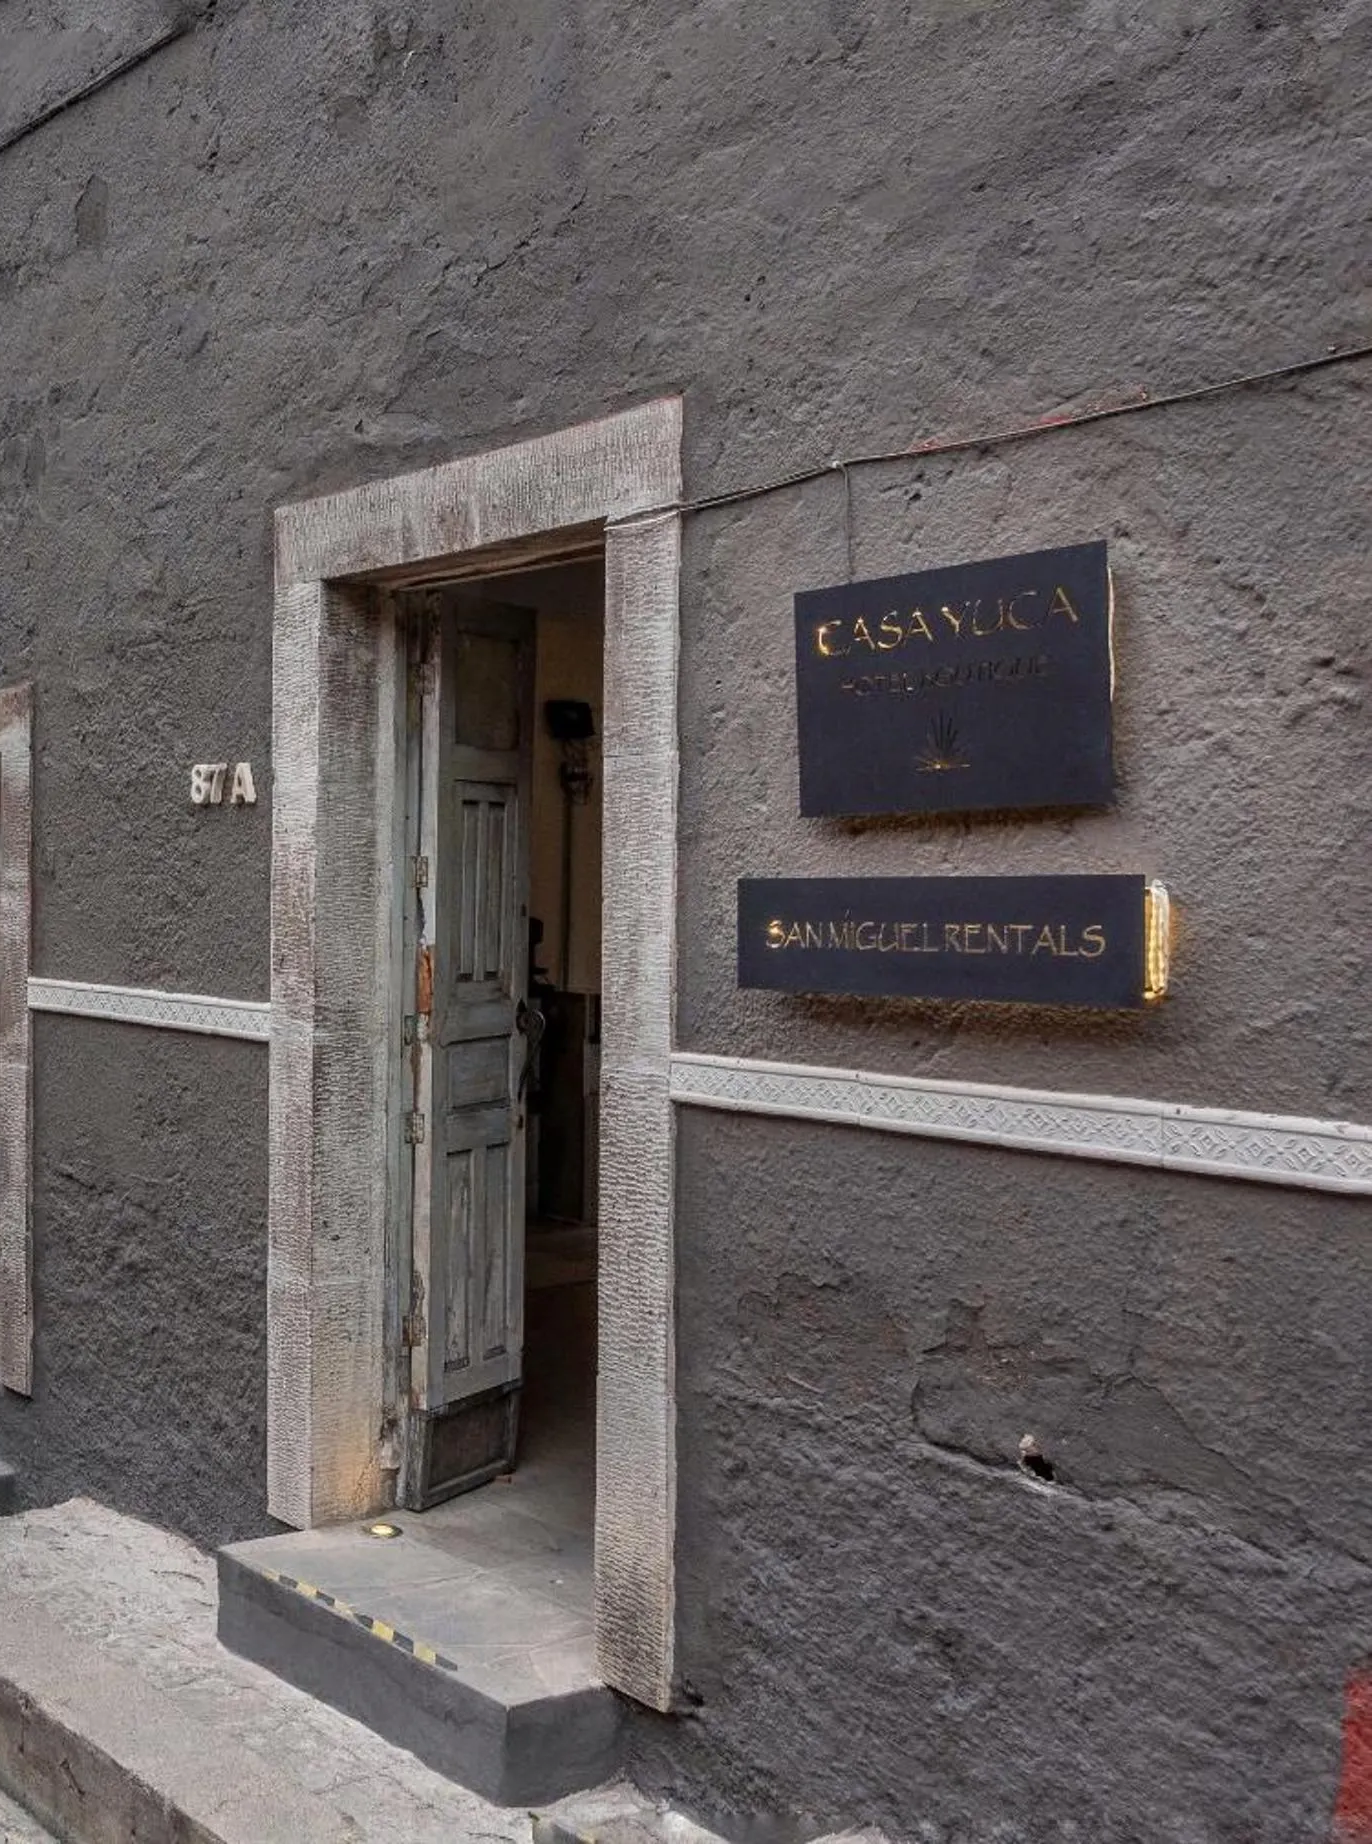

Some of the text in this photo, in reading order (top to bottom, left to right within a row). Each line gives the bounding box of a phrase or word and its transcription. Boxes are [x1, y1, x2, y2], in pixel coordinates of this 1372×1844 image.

[816, 585, 1079, 657] CASA YUCA
[765, 919, 823, 949] SAN
[944, 924, 1107, 958] RENTALS
